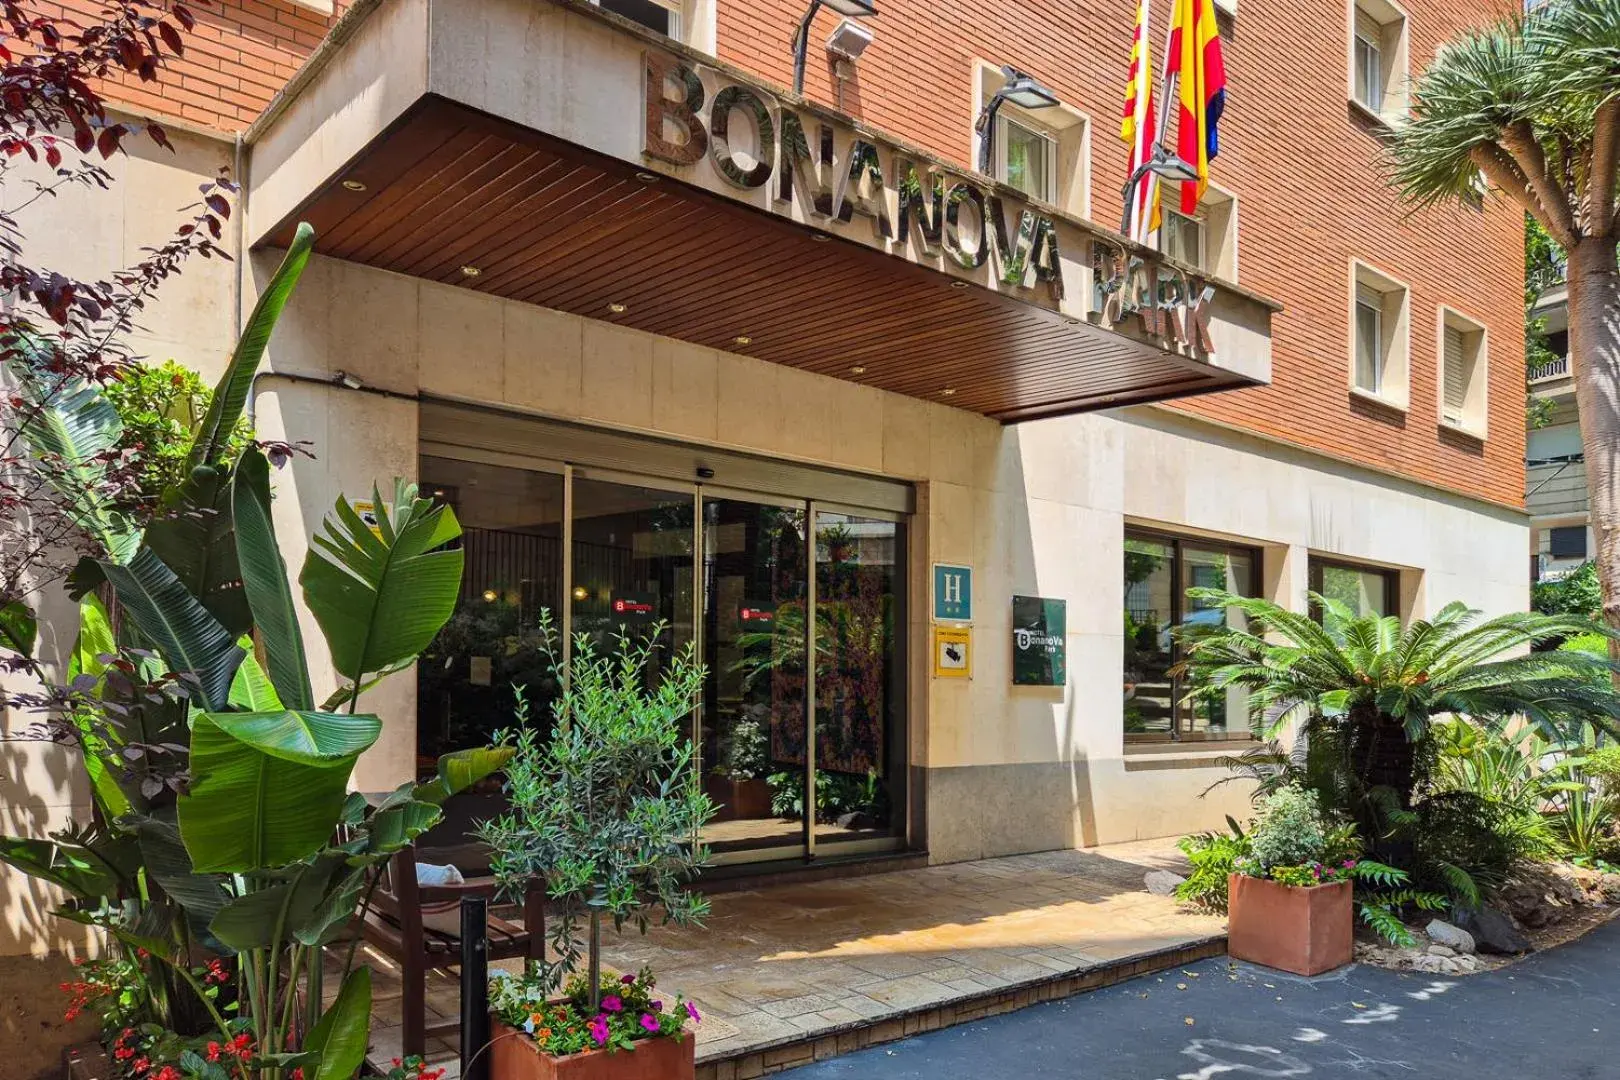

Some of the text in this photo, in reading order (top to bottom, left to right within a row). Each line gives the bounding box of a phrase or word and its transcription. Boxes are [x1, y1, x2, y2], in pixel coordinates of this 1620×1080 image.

[641, 51, 1216, 353] BONANOVA PARK
[944, 574, 961, 603] H
